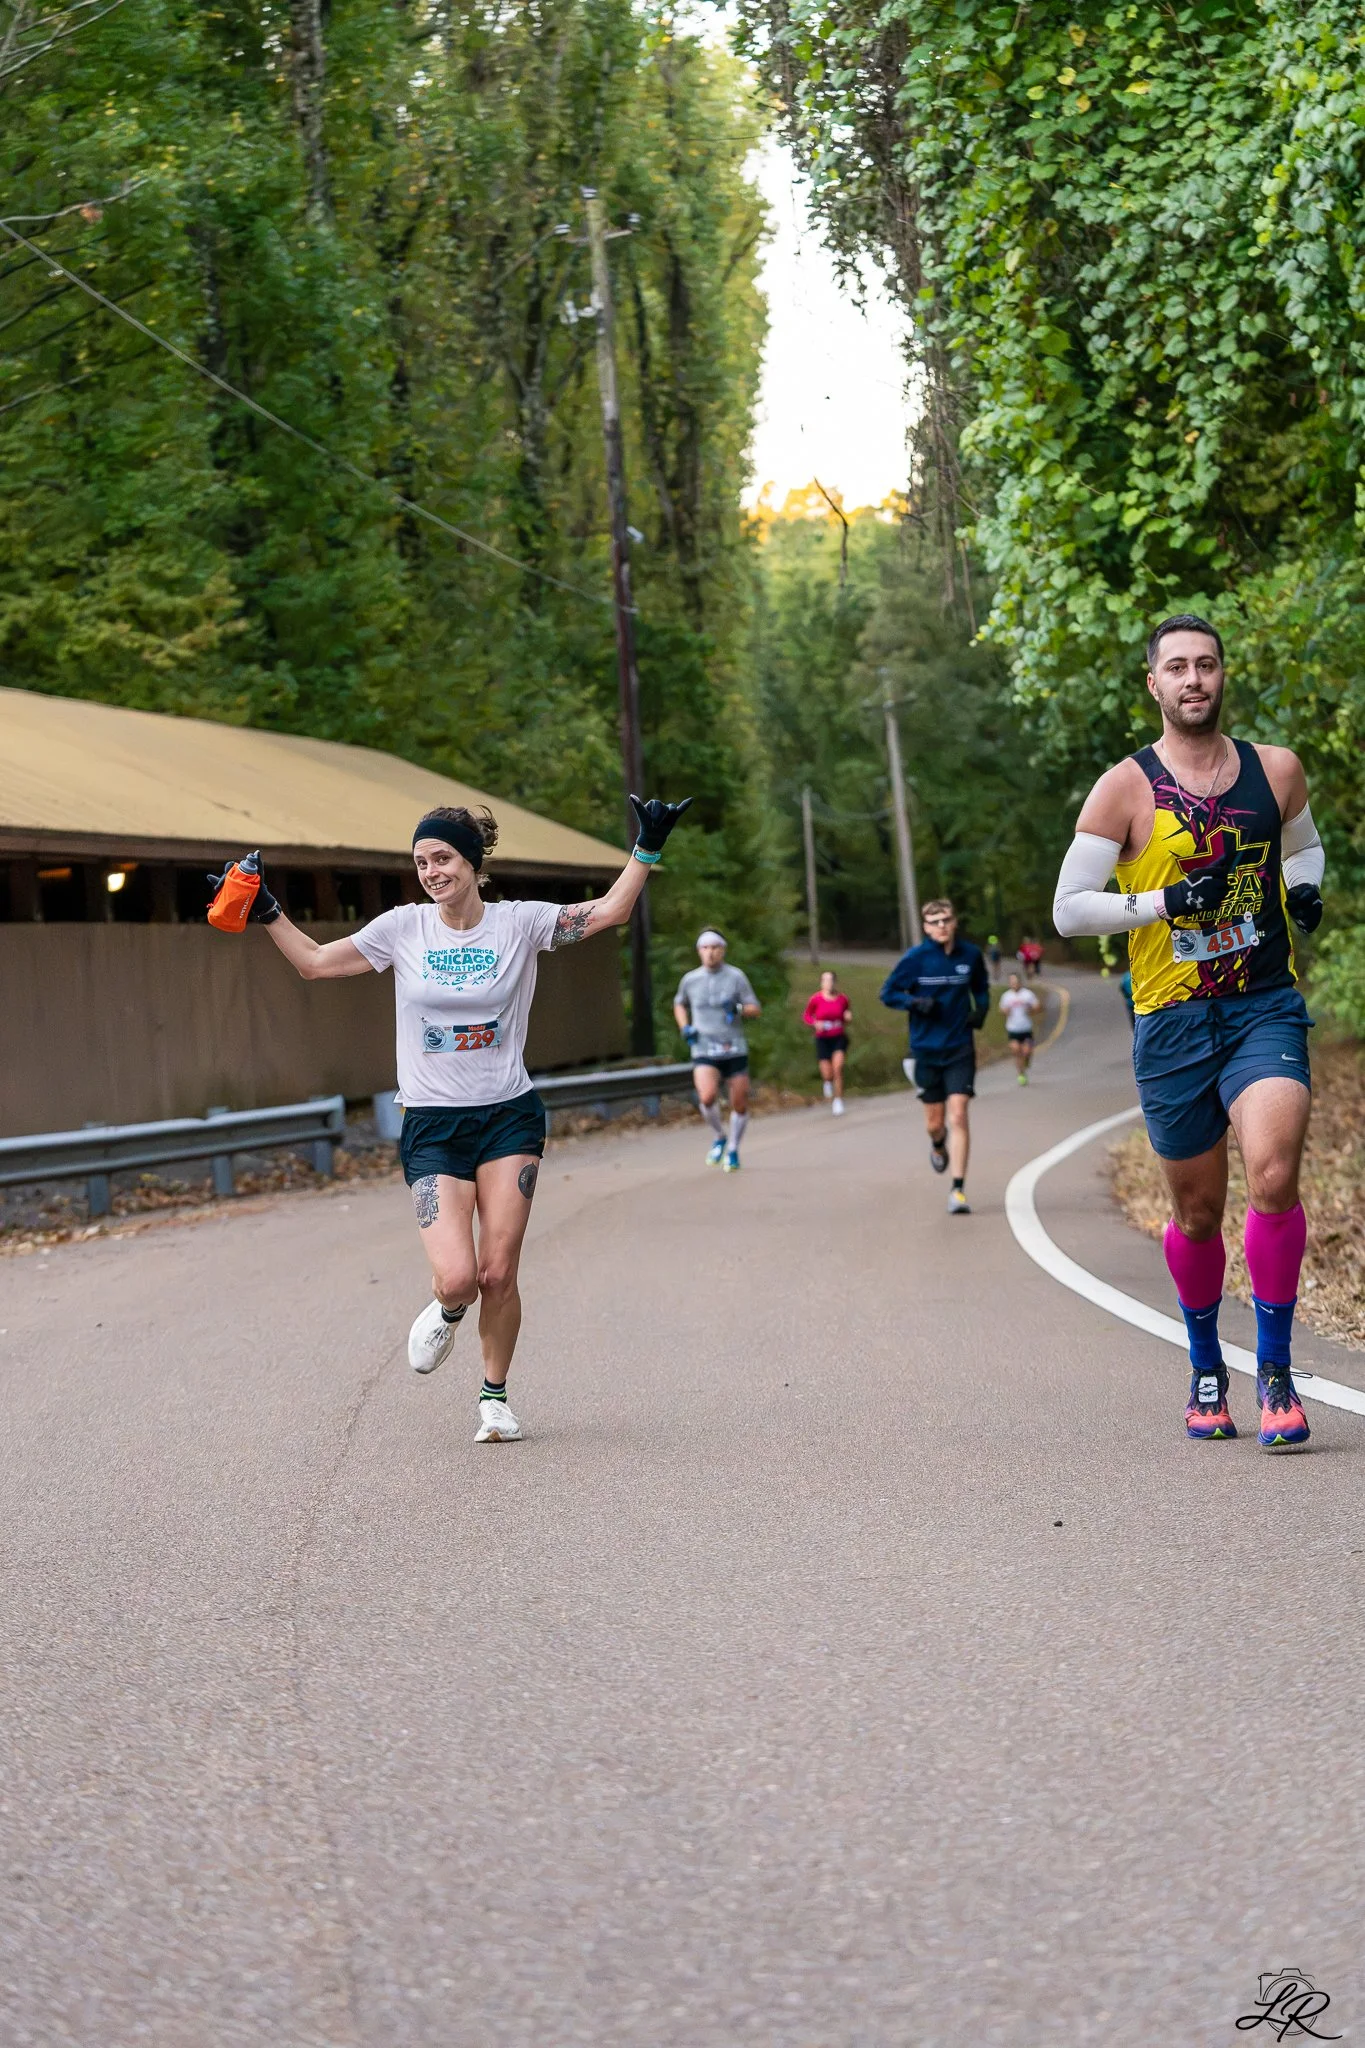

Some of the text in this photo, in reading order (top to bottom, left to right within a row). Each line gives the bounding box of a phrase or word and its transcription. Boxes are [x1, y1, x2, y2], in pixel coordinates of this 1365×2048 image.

[1207, 926, 1245, 953] 451
[461, 947, 494, 955] AMERICA
[427, 954, 495, 965] CHICAGO
[432, 964, 490, 972] MARATHON
[455, 1030, 495, 1051] 229
